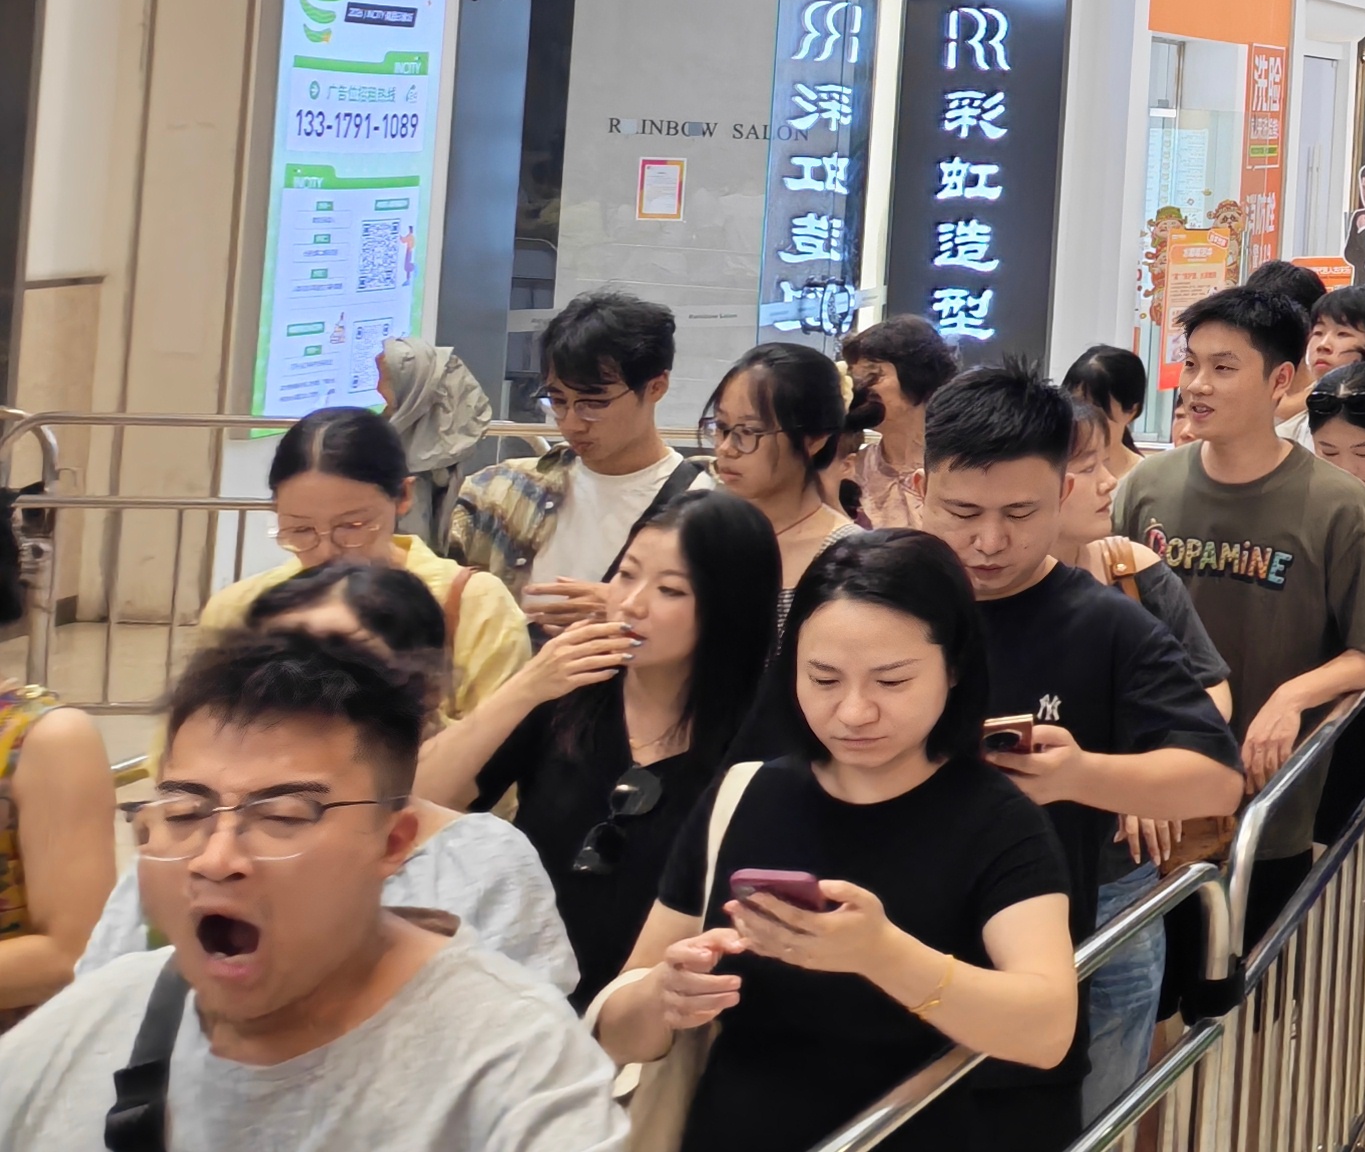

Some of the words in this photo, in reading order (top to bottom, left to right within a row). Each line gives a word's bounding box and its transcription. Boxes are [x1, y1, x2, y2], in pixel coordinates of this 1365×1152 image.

[296, 109, 419, 139] 133-1791-1089
[732, 123, 810, 141] SALON
[931, 89, 1009, 340] 彩虹造型
